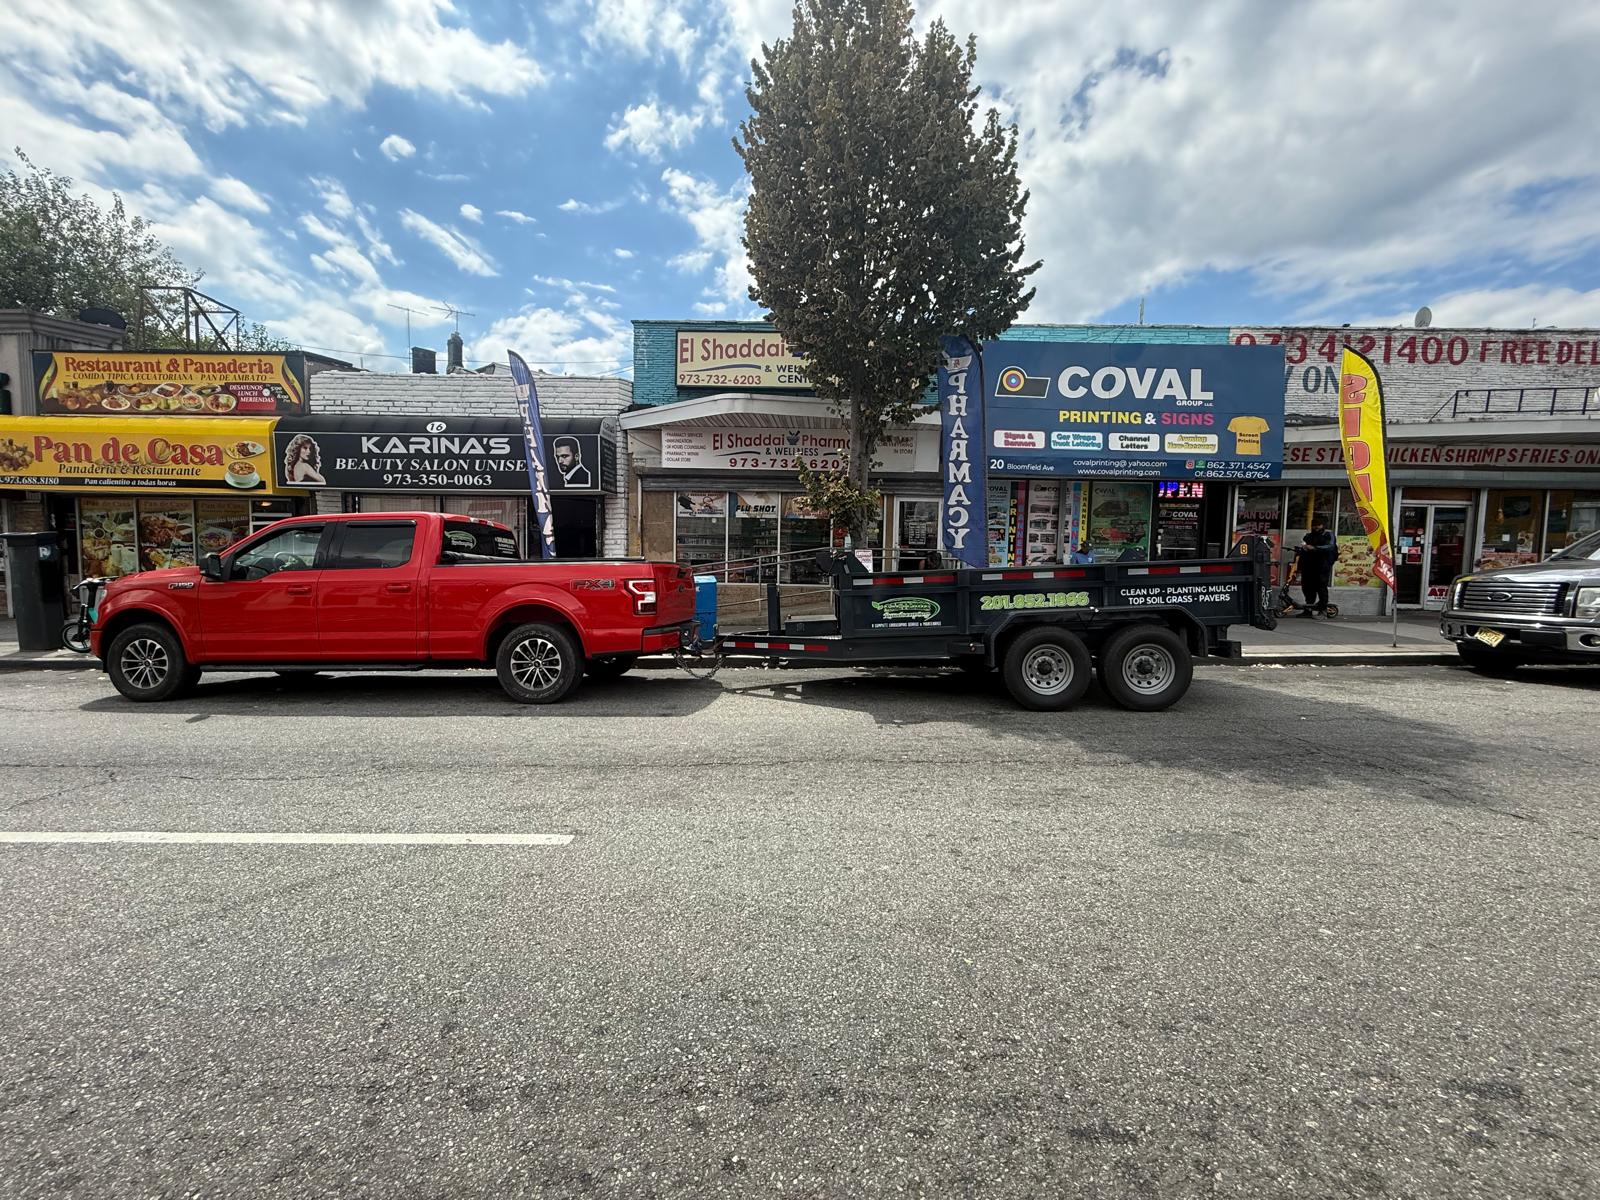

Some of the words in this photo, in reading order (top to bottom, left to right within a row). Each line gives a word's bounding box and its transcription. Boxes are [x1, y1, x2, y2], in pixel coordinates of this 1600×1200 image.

[679, 338, 694, 363] El
[701, 338, 785, 361] Shaddai
[1479, 340, 1550, 364] FREE
[64, 356, 162, 373] Restaurant
[166, 357, 180, 373] &
[183, 357, 274, 374] Panaderia
[764, 365, 772, 373] &
[136, 373, 193, 381] ECUATORIANA
[679, 374, 762, 385] 973-732-6203
[1057, 365, 1214, 400] COVAL
[1058, 410, 1142, 424] PRINTING
[1144, 412, 1157, 425] &
[1160, 412, 1215, 426] SIGNS
[429, 423, 443, 431] 16
[712, 433, 723, 451] El
[727, 432, 785, 449] Shaddai
[1004, 432, 1026, 440] Signs
[1027, 432, 1034, 440] &
[1072, 433, 1096, 441] Wraps
[1118, 435, 1150, 443] Channel
[361, 436, 511, 455] KARINA'S
[1071, 440, 1102, 448] Lettering
[1120, 442, 1149, 450] Letters
[33, 435, 93, 463] Pan
[101, 436, 140, 464] de
[147, 437, 225, 466] Casa
[765, 447, 771, 455] &
[1387, 447, 1442, 463] HICKEN
[120, 465, 129, 475] &
[132, 465, 202, 476] Restaurante
[335, 458, 408, 471] BEAUTY
[410, 458, 469, 471] SALON
[474, 459, 528, 472] UNISE
[990, 459, 1005, 469] 20
[1007, 463, 1042, 471] Bloomfield
[1207, 461, 1272, 470] 862.371.4547
[1077, 468, 1161, 477] www.covalprinting.com
[3, 477, 60, 485] 973.688.8180
[99, 478, 131, 486] calientito
[383, 473, 493, 486] 973-350-0063
[736, 504, 752, 512] FLU
[753, 504, 776, 512] SHOT
[1172, 510, 1199, 518] COVAL
[571, 579, 615, 591] FX4
[1120, 588, 1148, 596] CLEAN
[1167, 586, 1207, 595] PLANTING
[1208, 585, 1238, 593] MULCH
[1128, 597, 1145, 605] TOP
[1146, 596, 1165, 604] SOIL
[1165, 595, 1193, 604] GRASS
[1198, 593, 1231, 602] PAVERS
